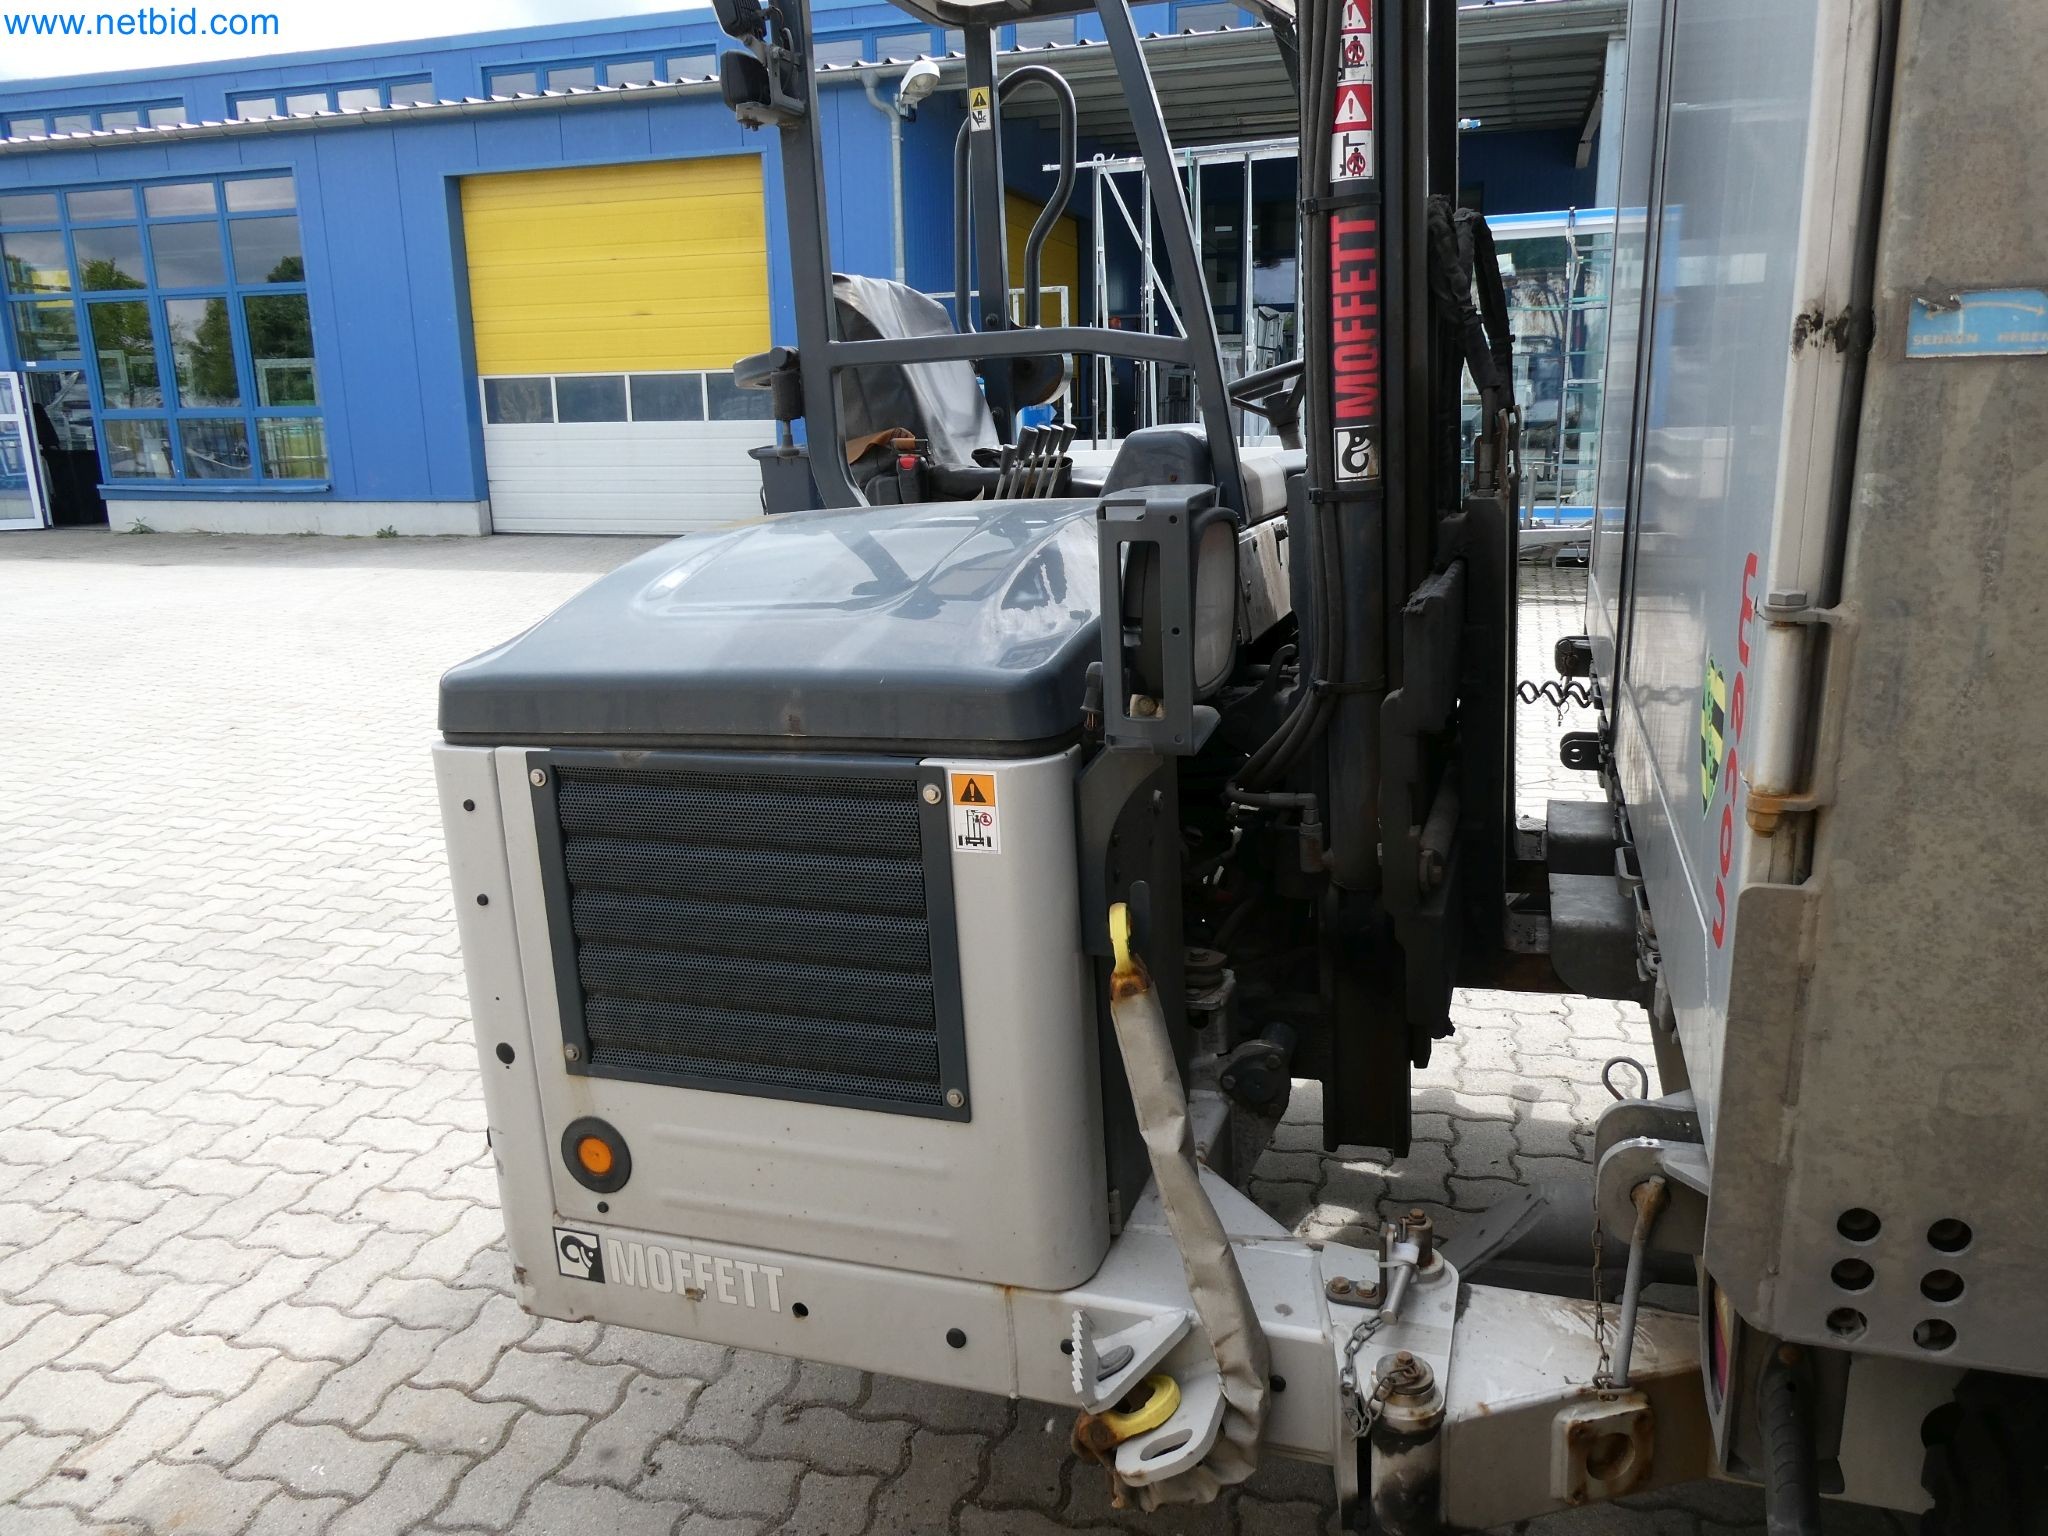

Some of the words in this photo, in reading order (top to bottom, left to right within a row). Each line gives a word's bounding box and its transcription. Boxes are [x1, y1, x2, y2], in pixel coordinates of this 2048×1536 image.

[1330, 215, 1378, 419] MOFFETT
[1712, 552, 1759, 950] wecon
[606, 1238, 784, 1313] MOFFETT
